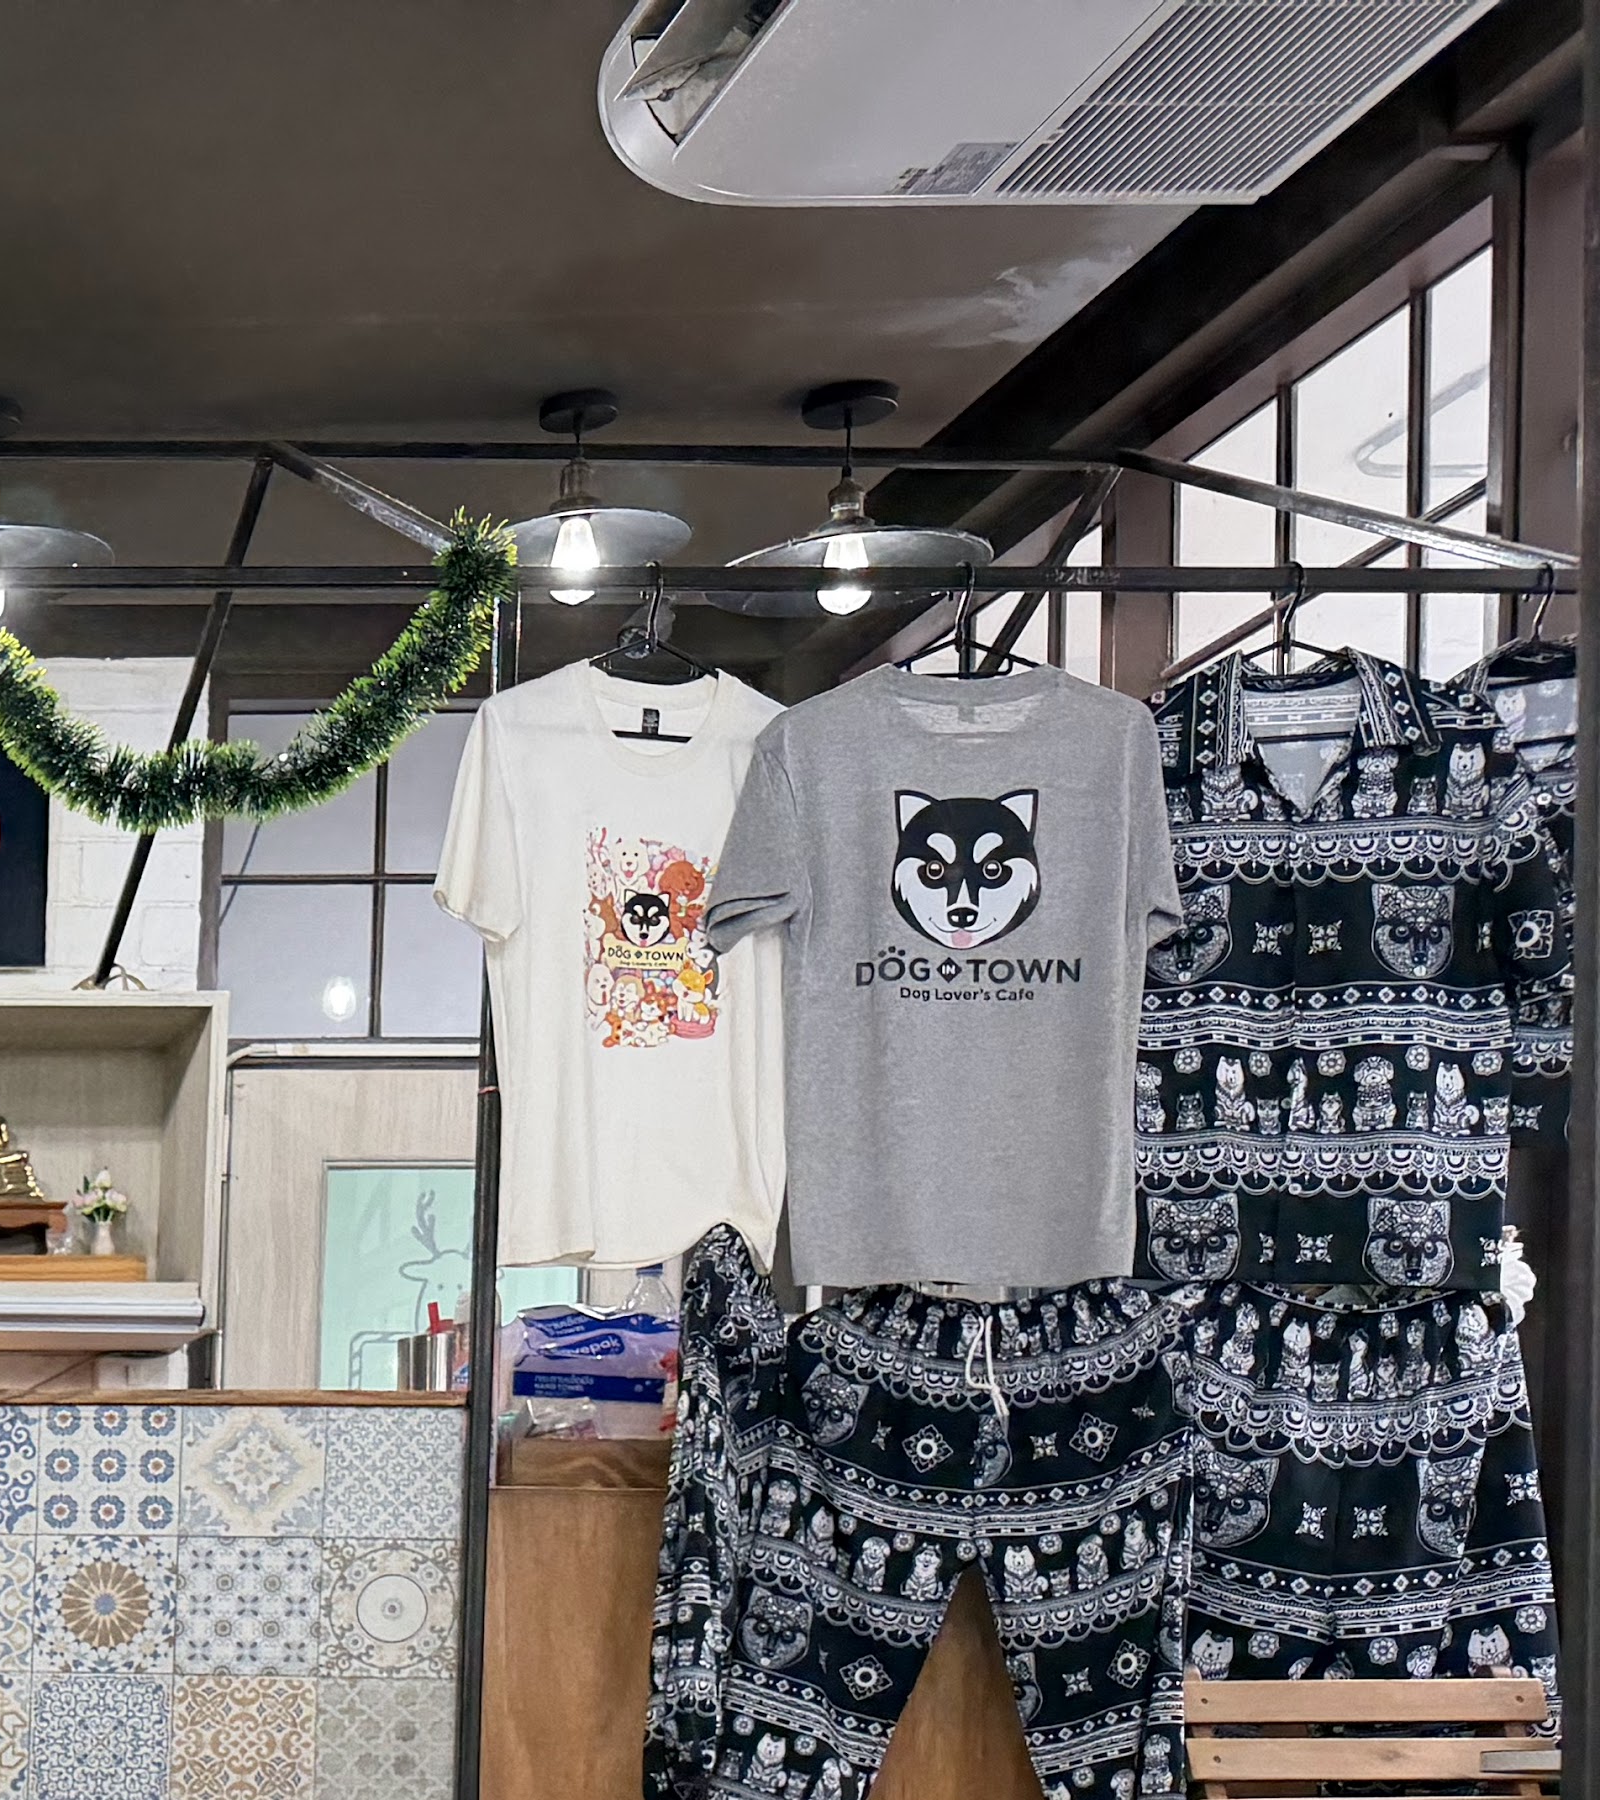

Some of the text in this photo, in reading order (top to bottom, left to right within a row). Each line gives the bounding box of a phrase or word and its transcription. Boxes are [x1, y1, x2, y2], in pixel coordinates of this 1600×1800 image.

[645, 950, 684, 961] TOWN
[941, 964, 956, 976] IN
[966, 957, 1082, 984] TOWN
[900, 987, 1035, 1001] Dog Lover's Cafe
